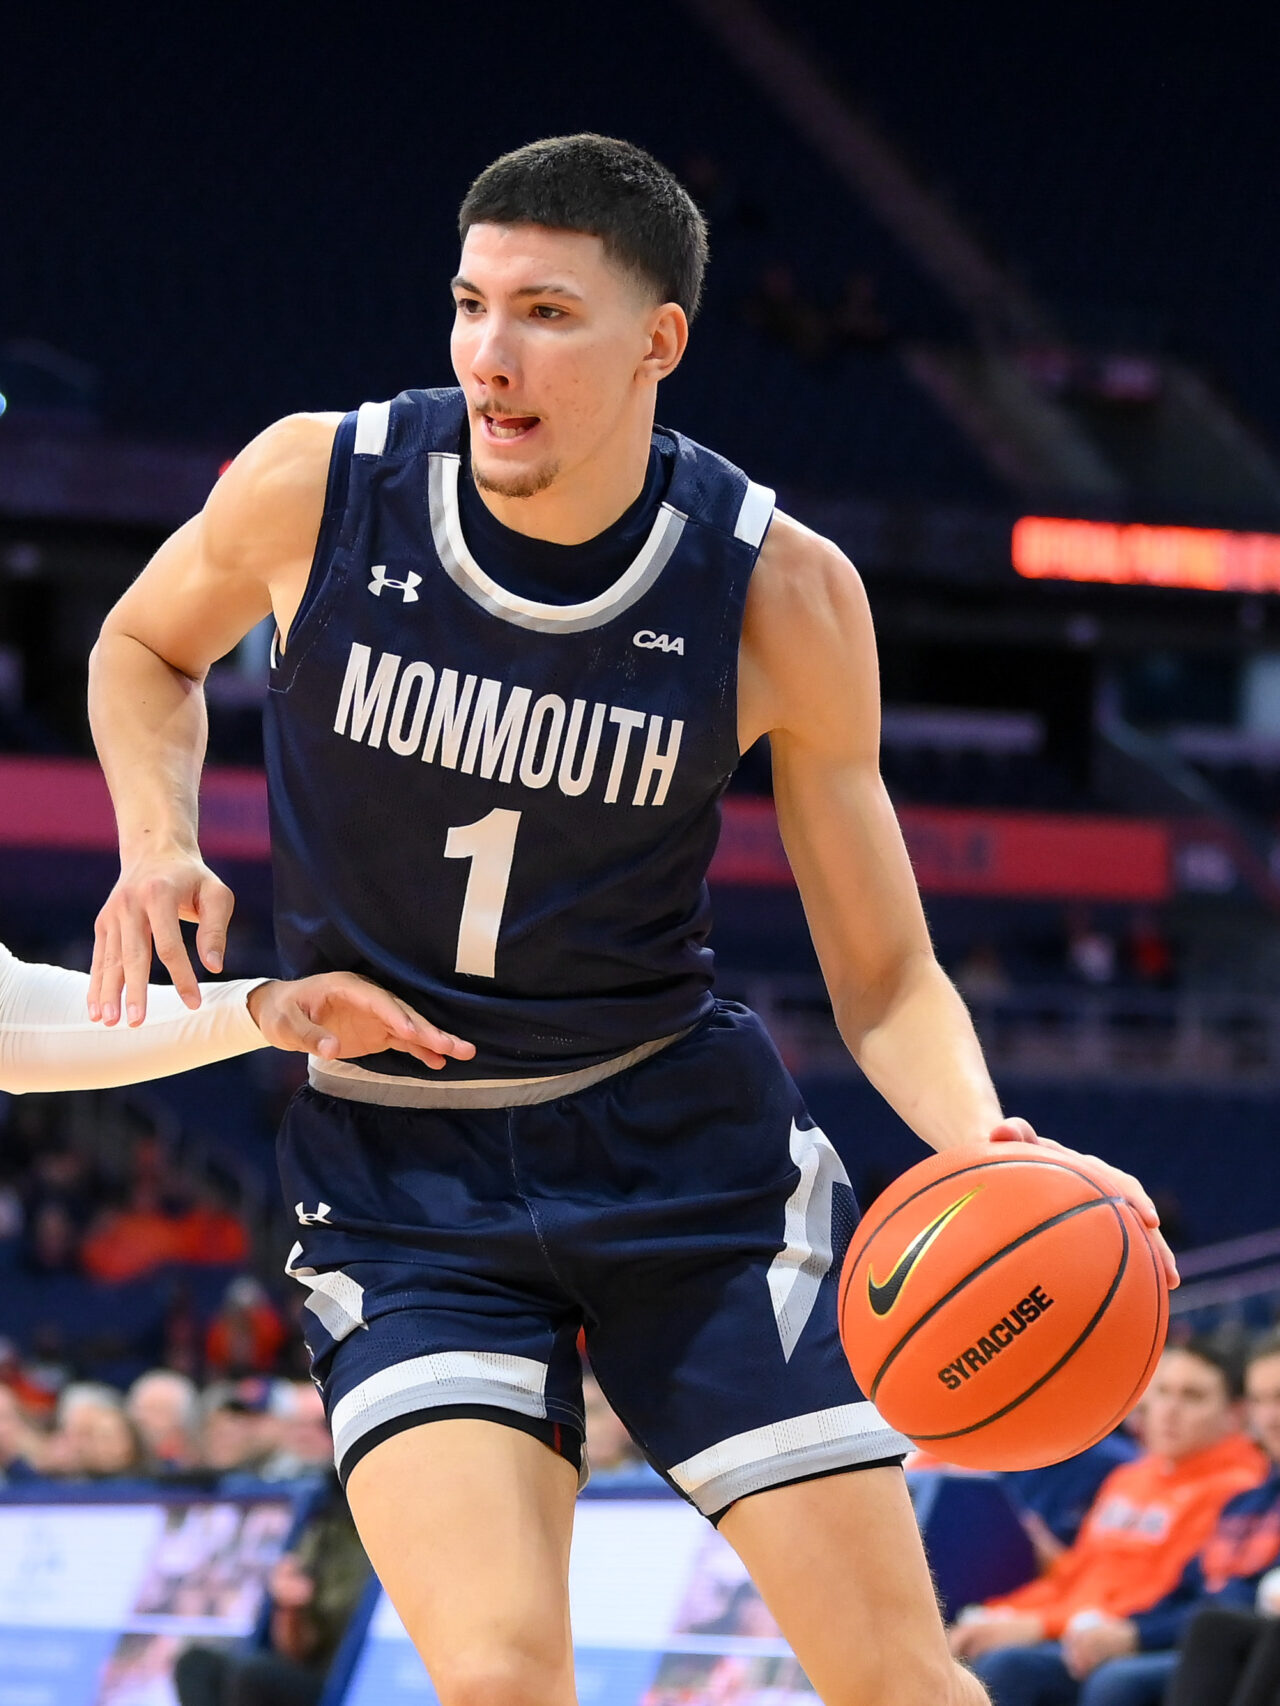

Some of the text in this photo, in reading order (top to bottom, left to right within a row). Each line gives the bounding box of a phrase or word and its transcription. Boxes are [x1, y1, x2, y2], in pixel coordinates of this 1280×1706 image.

[632, 630, 684, 655] CAA
[333, 642, 684, 806] MONMOUTH
[443, 807, 522, 978] 1
[938, 1285, 1054, 1390] SYRACUSE
